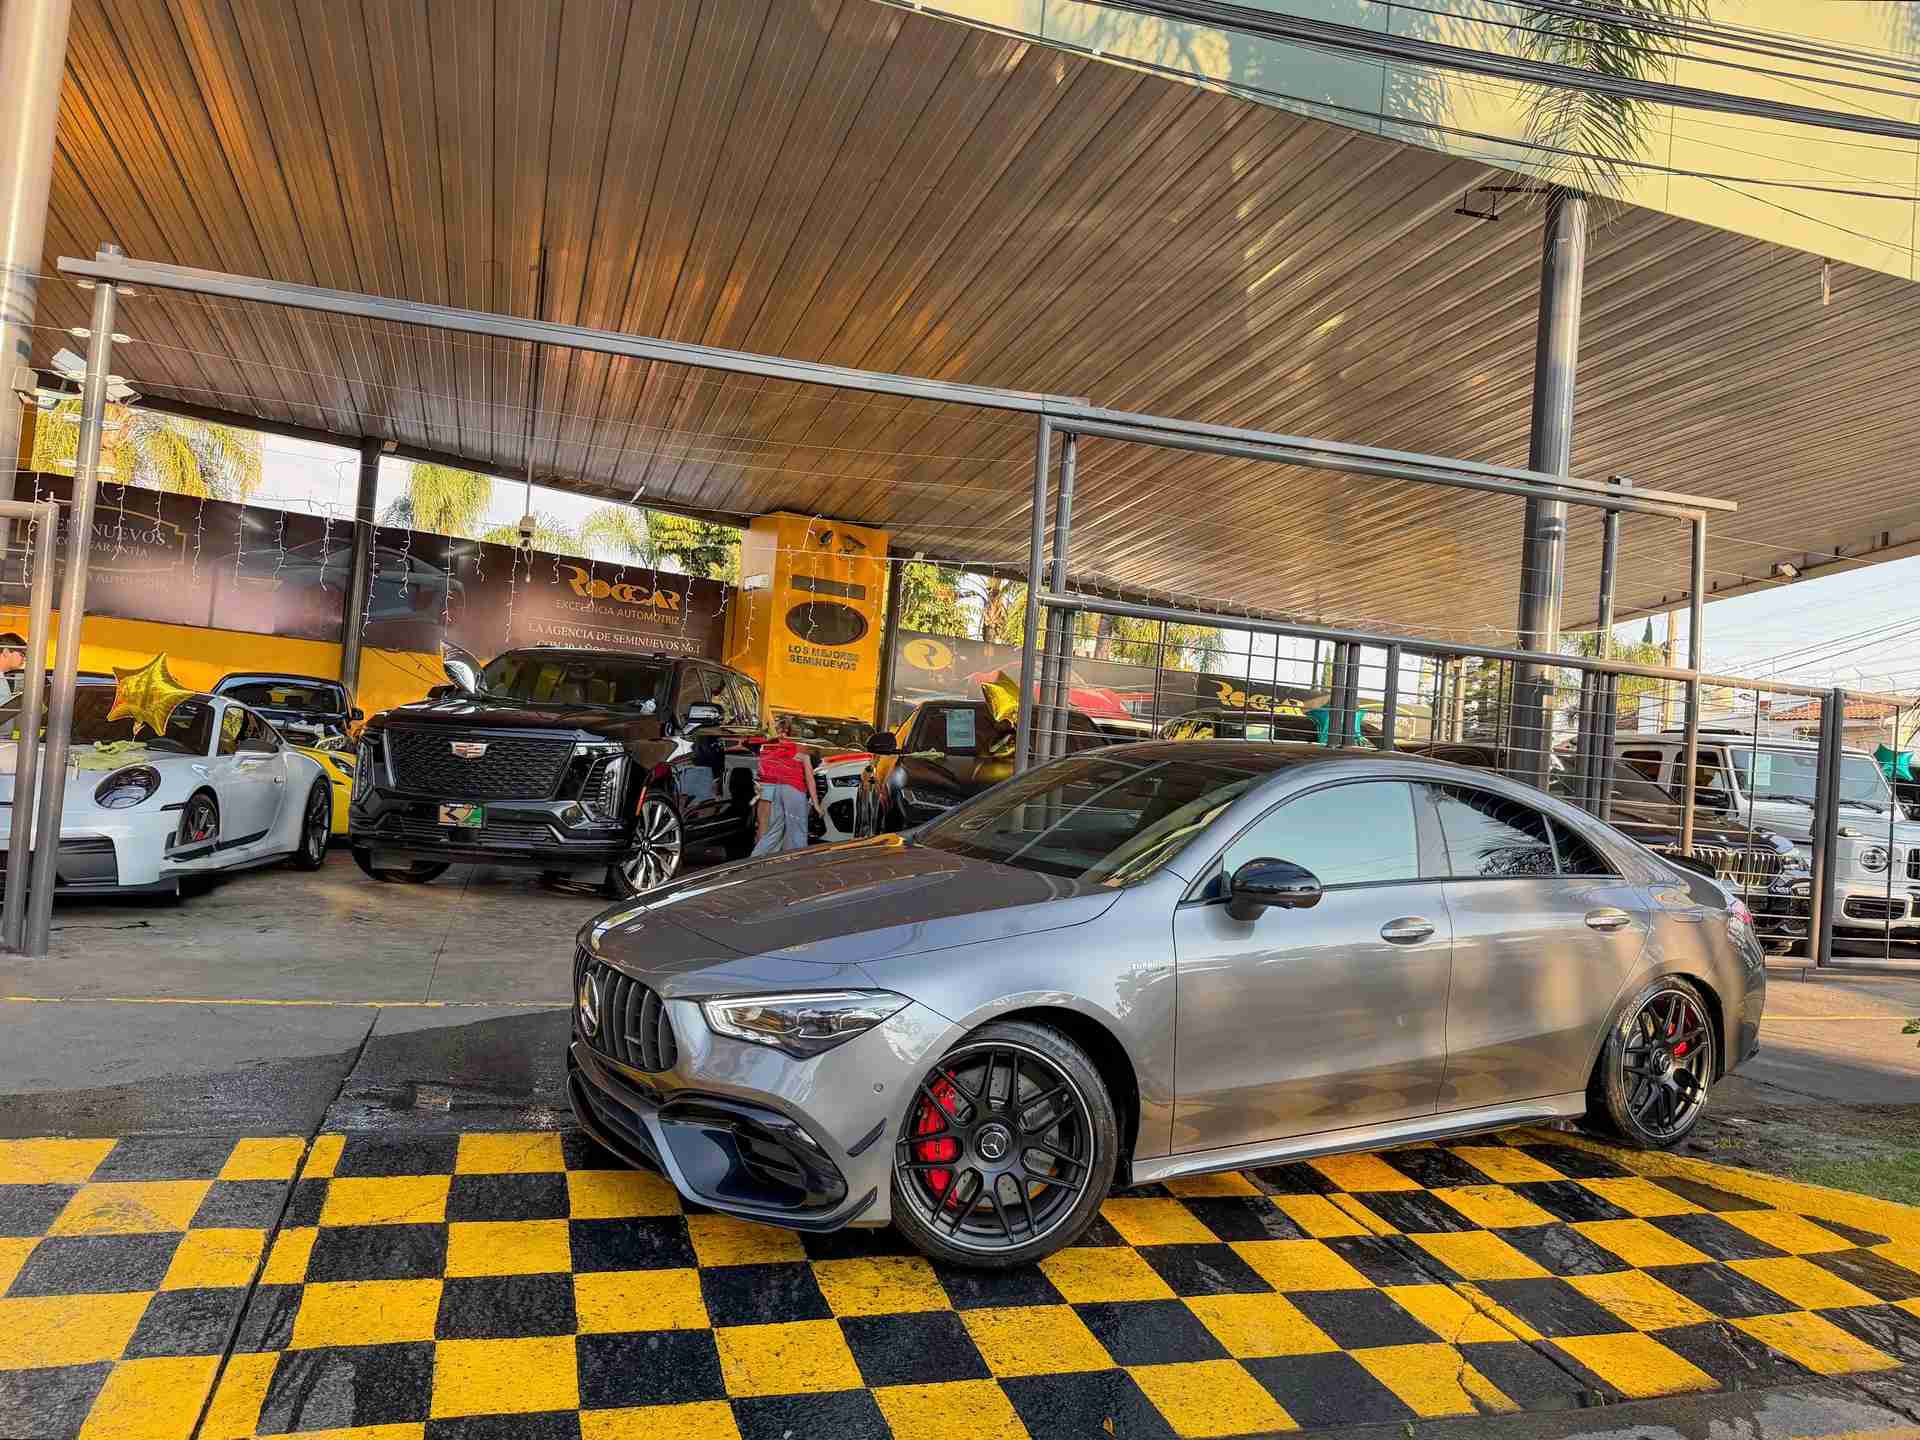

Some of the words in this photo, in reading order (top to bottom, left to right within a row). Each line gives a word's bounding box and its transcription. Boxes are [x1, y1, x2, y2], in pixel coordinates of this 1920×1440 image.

[560, 563, 681, 611] ROCCAR
[555, 599, 615, 615] EXCELENCIA
[616, 607, 680, 625] AUTOMOTRIZ
[528, 622, 544, 633] LA
[544, 623, 595, 640] AGENCIA
[596, 631, 610, 642] DE
[612, 634, 679, 651] SEMINUEVOS
[788, 644, 809, 655] LOS
[790, 654, 857, 672] SEMINUEVOS
